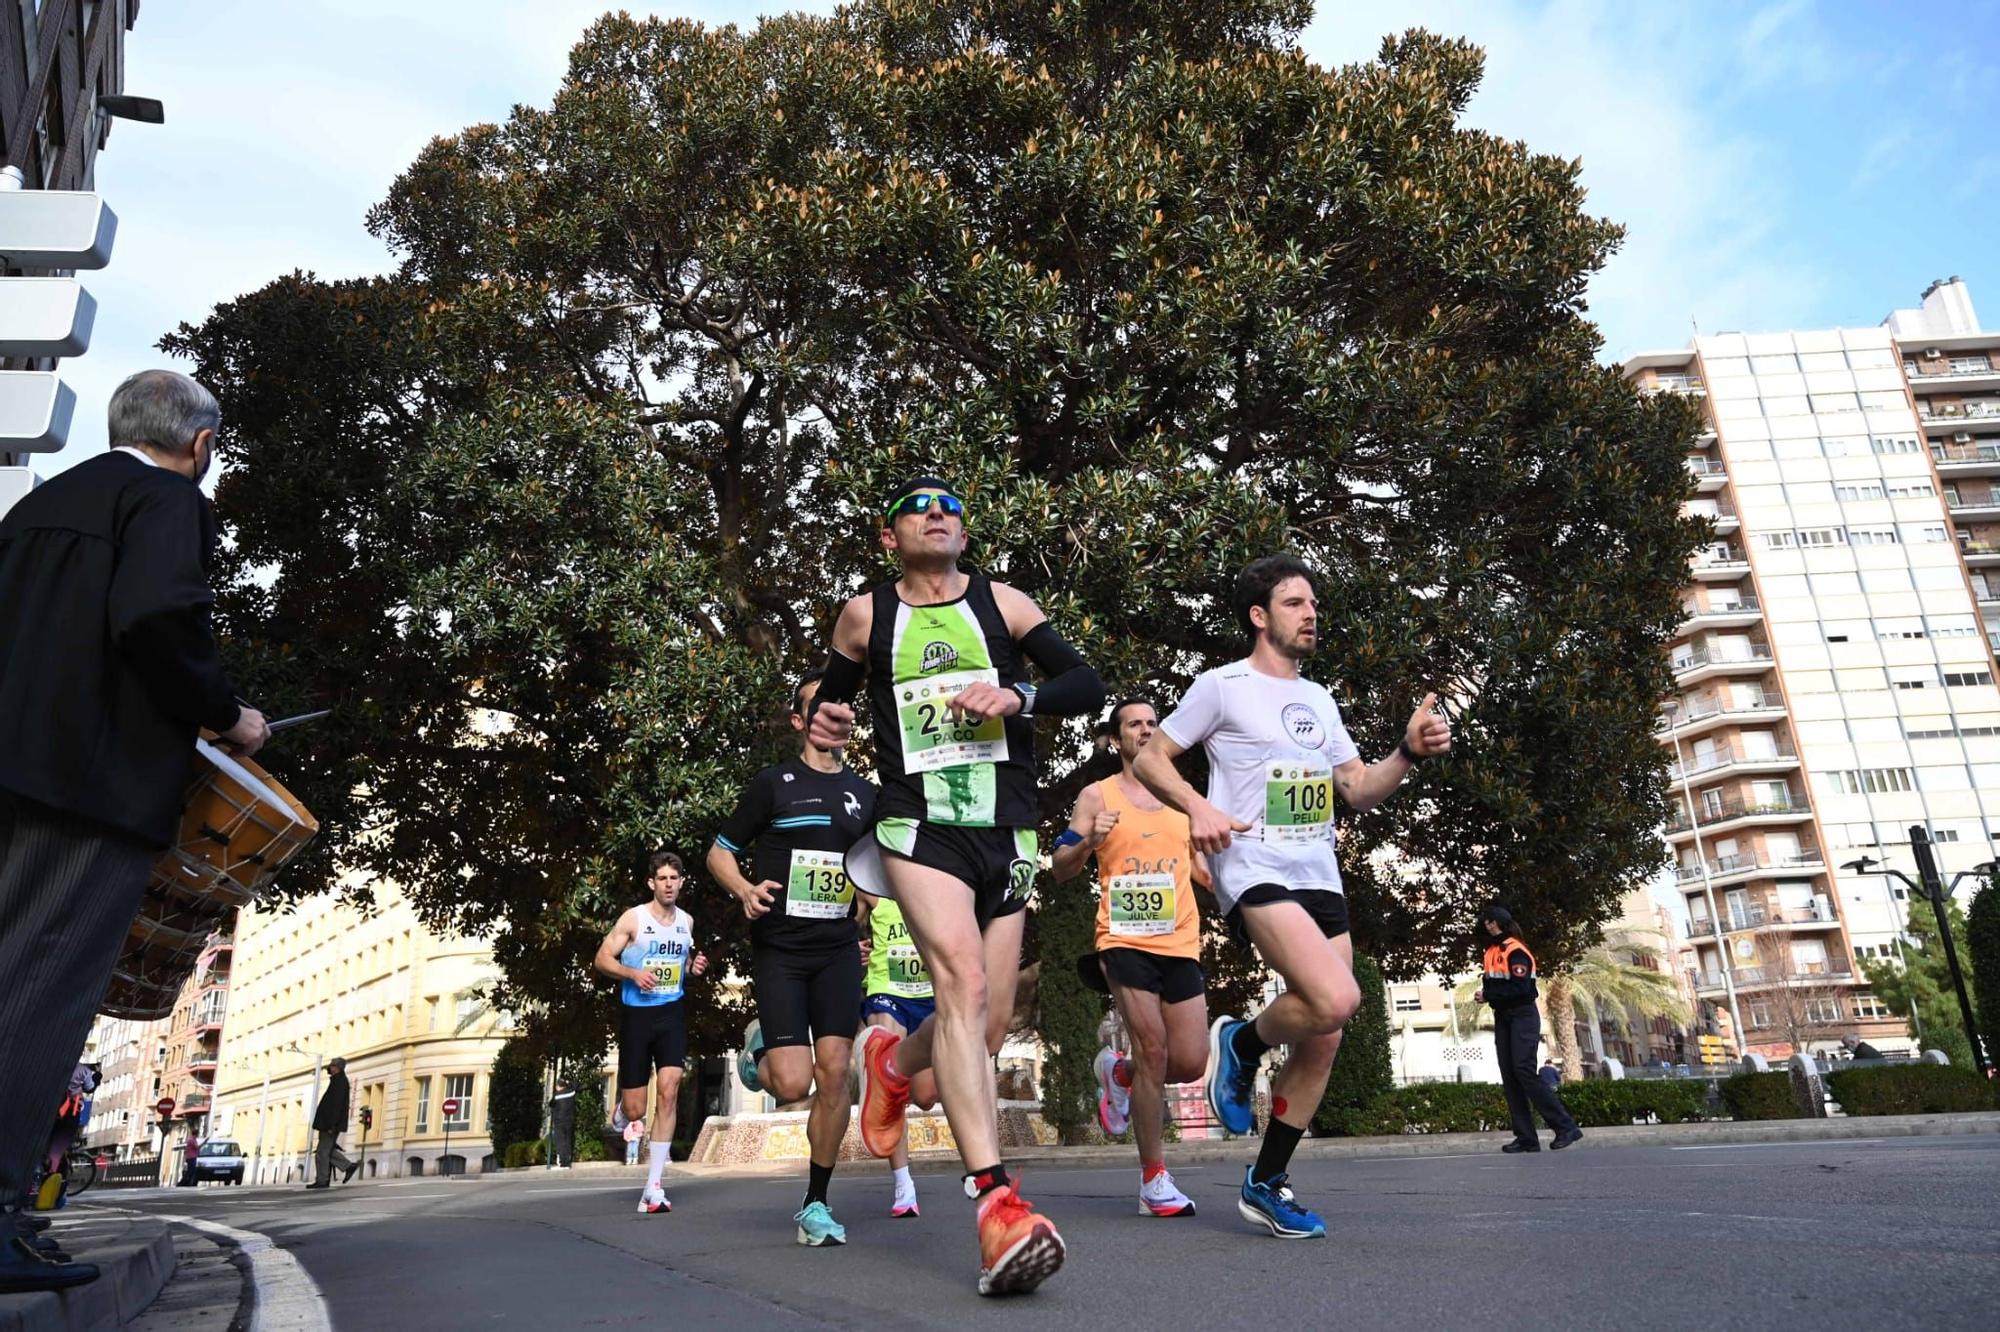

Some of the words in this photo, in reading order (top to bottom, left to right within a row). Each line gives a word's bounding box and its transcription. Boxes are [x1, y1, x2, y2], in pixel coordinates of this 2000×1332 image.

[933, 729, 975, 745] PACO
[1284, 783, 1326, 812] 108
[1293, 812, 1320, 824] PELU
[805, 870, 847, 893] 139
[810, 892, 837, 903] LERA
[1122, 891, 1163, 912] 339
[1128, 912, 1160, 921] JULVE
[649, 940, 683, 955] Delta
